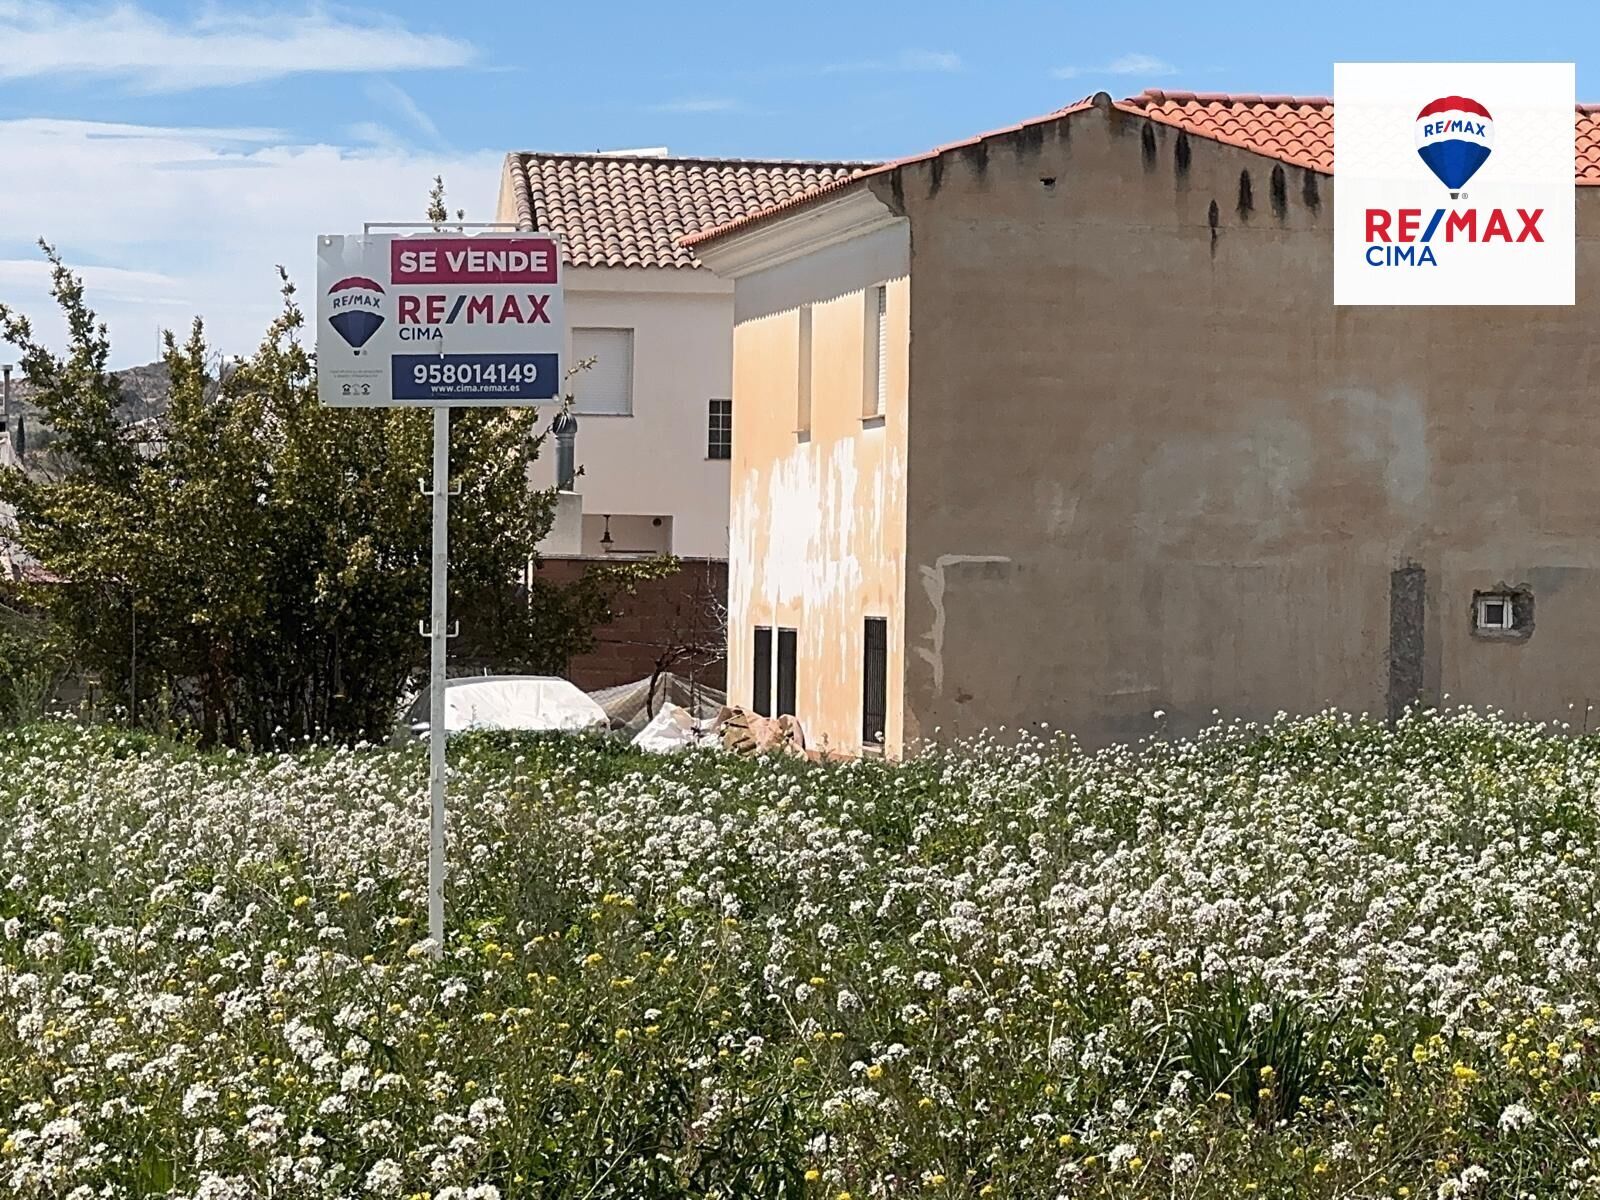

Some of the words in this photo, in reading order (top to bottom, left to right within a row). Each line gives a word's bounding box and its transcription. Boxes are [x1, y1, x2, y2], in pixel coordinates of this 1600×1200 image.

[399, 250, 437, 273] SE
[445, 250, 548, 273] VENDE
[332, 294, 382, 310] RE/MAX
[398, 294, 551, 325] RE/MAX
[399, 327, 443, 341] CIMA
[413, 363, 537, 384] 958014149
[430, 384, 521, 393] www.cima.remax.es
